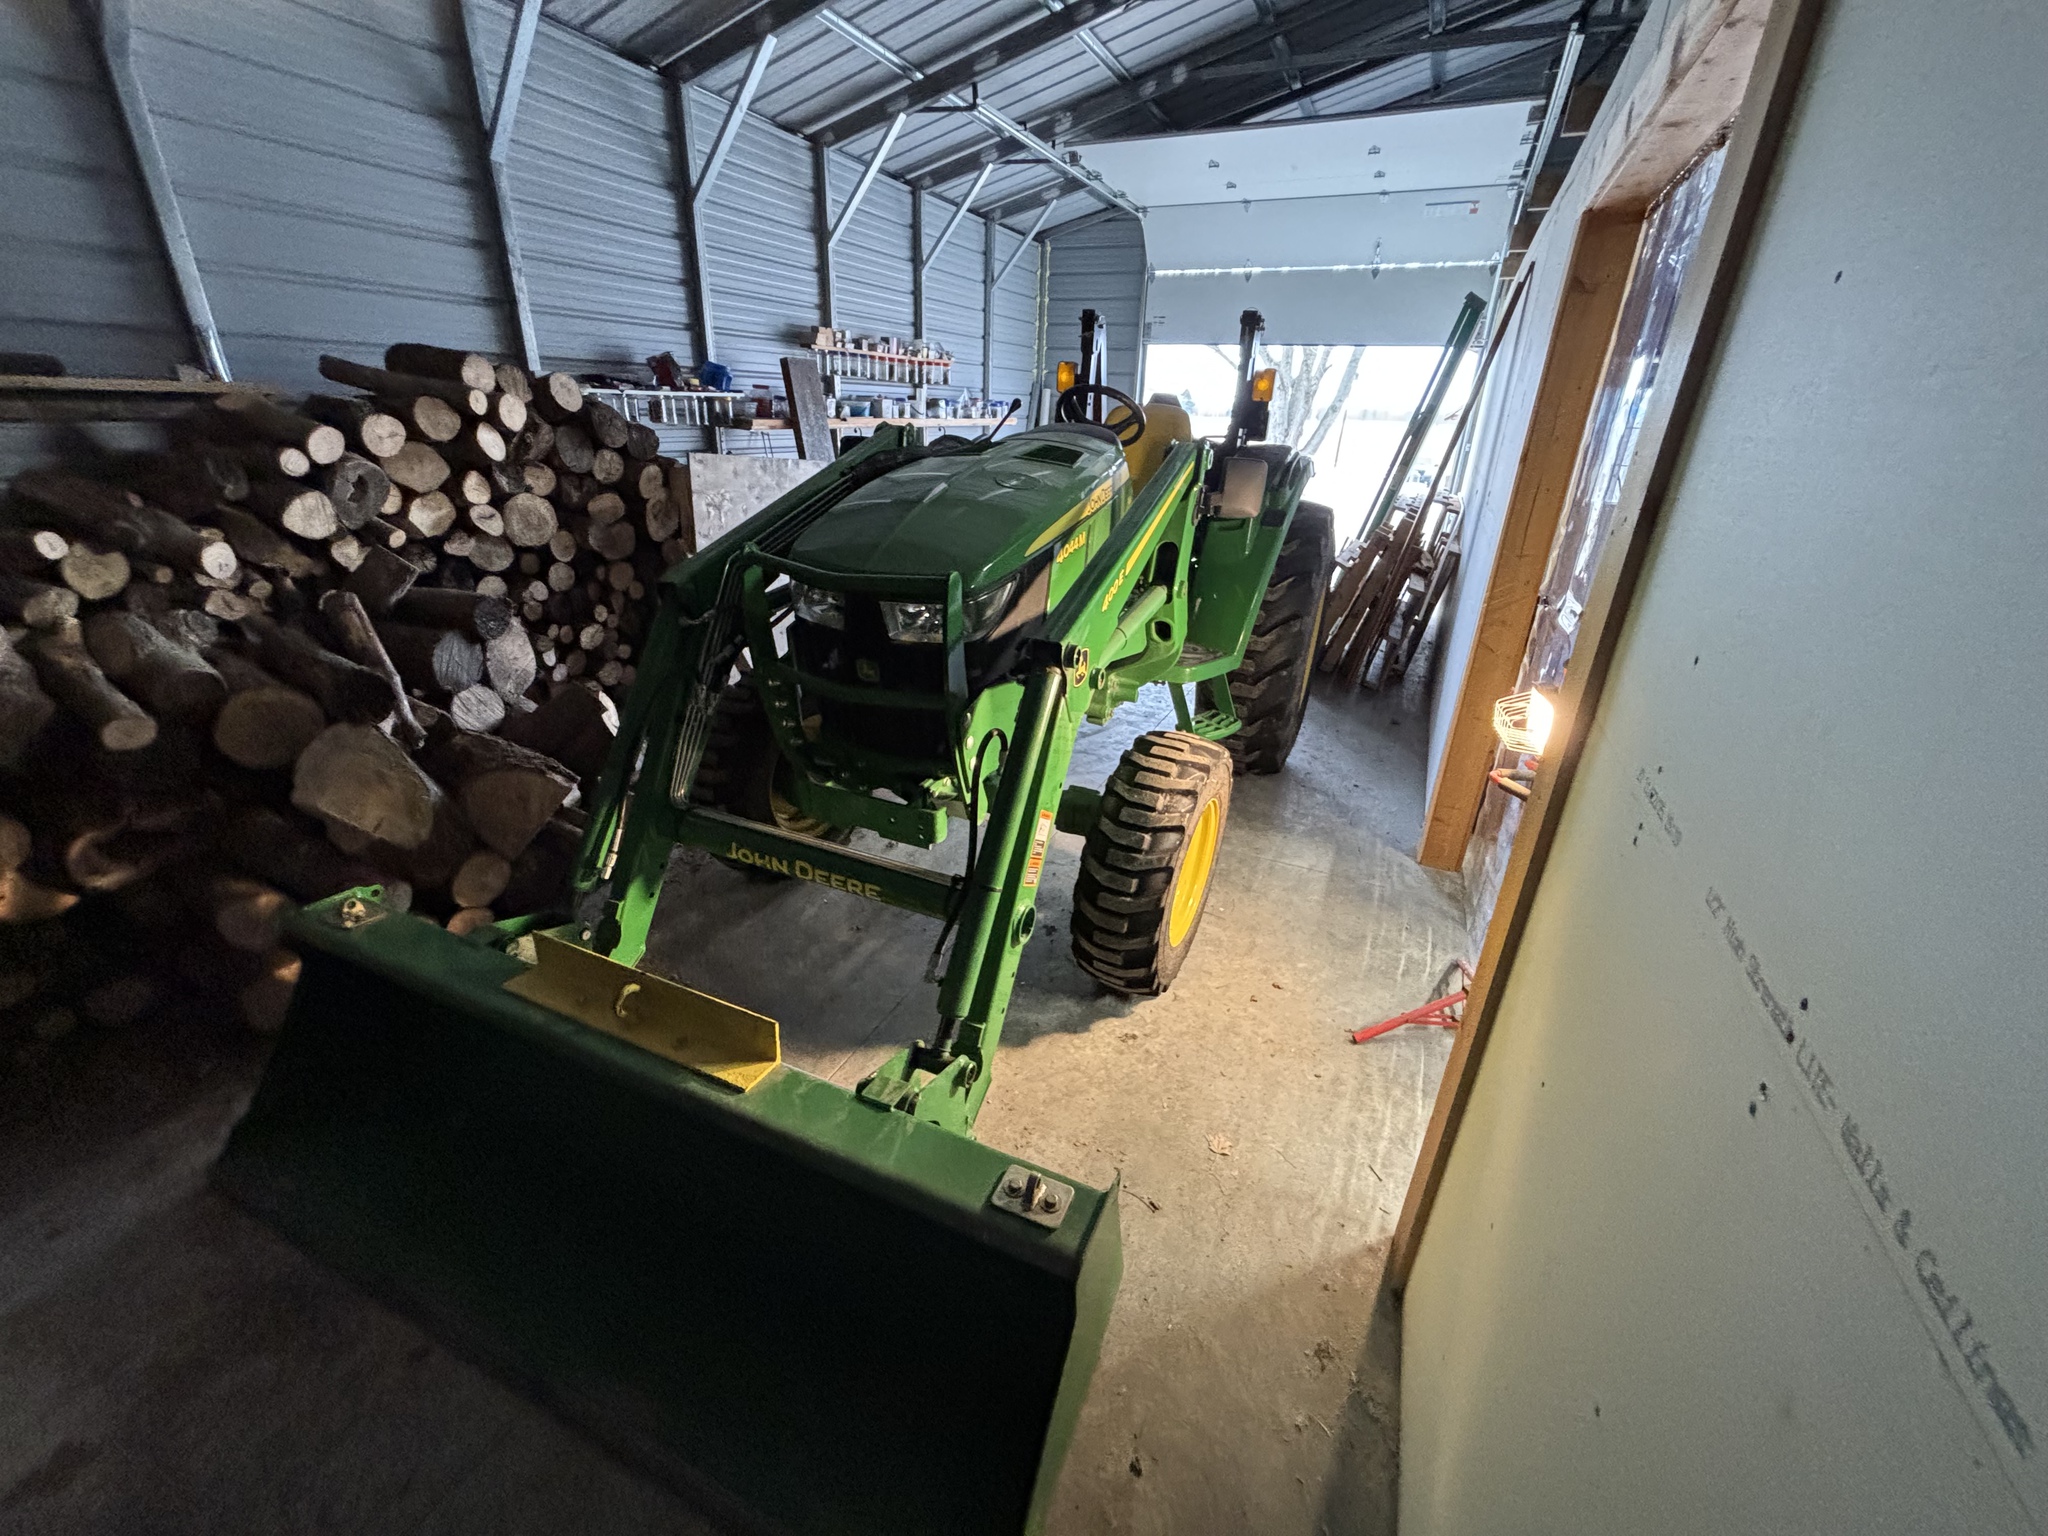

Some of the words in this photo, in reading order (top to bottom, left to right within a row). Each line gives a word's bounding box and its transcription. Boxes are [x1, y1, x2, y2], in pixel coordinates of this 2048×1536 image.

[1102, 569, 1124, 612] 400E
[726, 842, 791, 876] JOHN
[795, 859, 882, 901] DEERE
